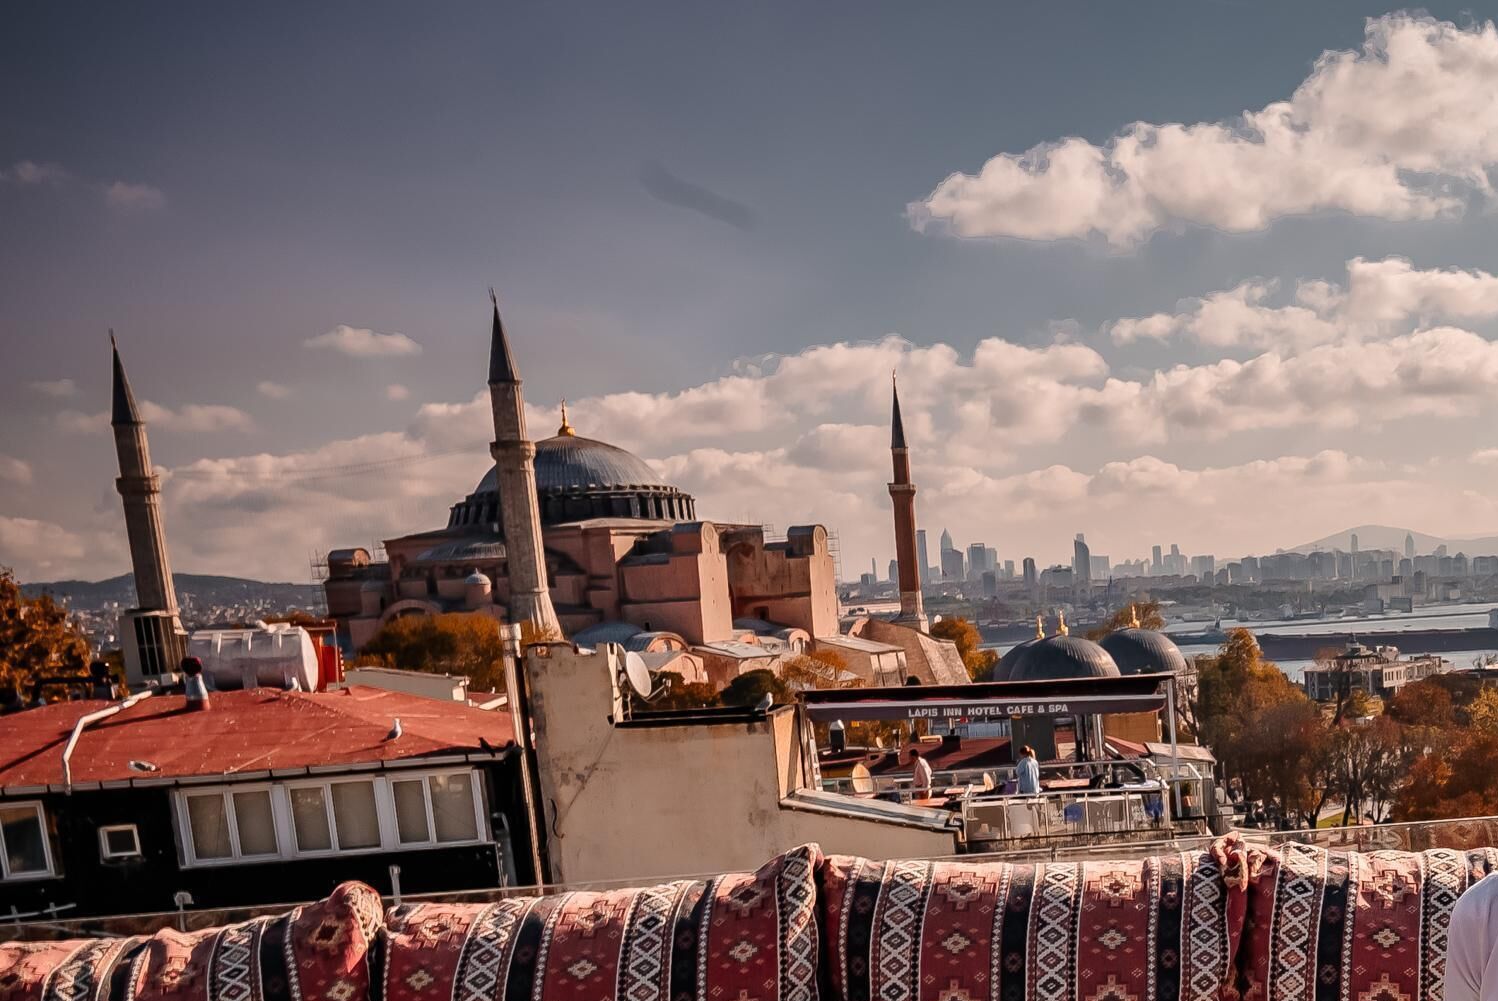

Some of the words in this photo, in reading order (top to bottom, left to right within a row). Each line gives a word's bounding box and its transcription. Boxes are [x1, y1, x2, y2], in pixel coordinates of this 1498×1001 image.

[908, 708, 938, 718] LAPIS
[943, 707, 962, 717] INN
[967, 706, 1002, 716] HOTEL
[1007, 705, 1034, 715] CAFE
[1037, 704, 1045, 714] &
[1048, 704, 1069, 713] SPA
